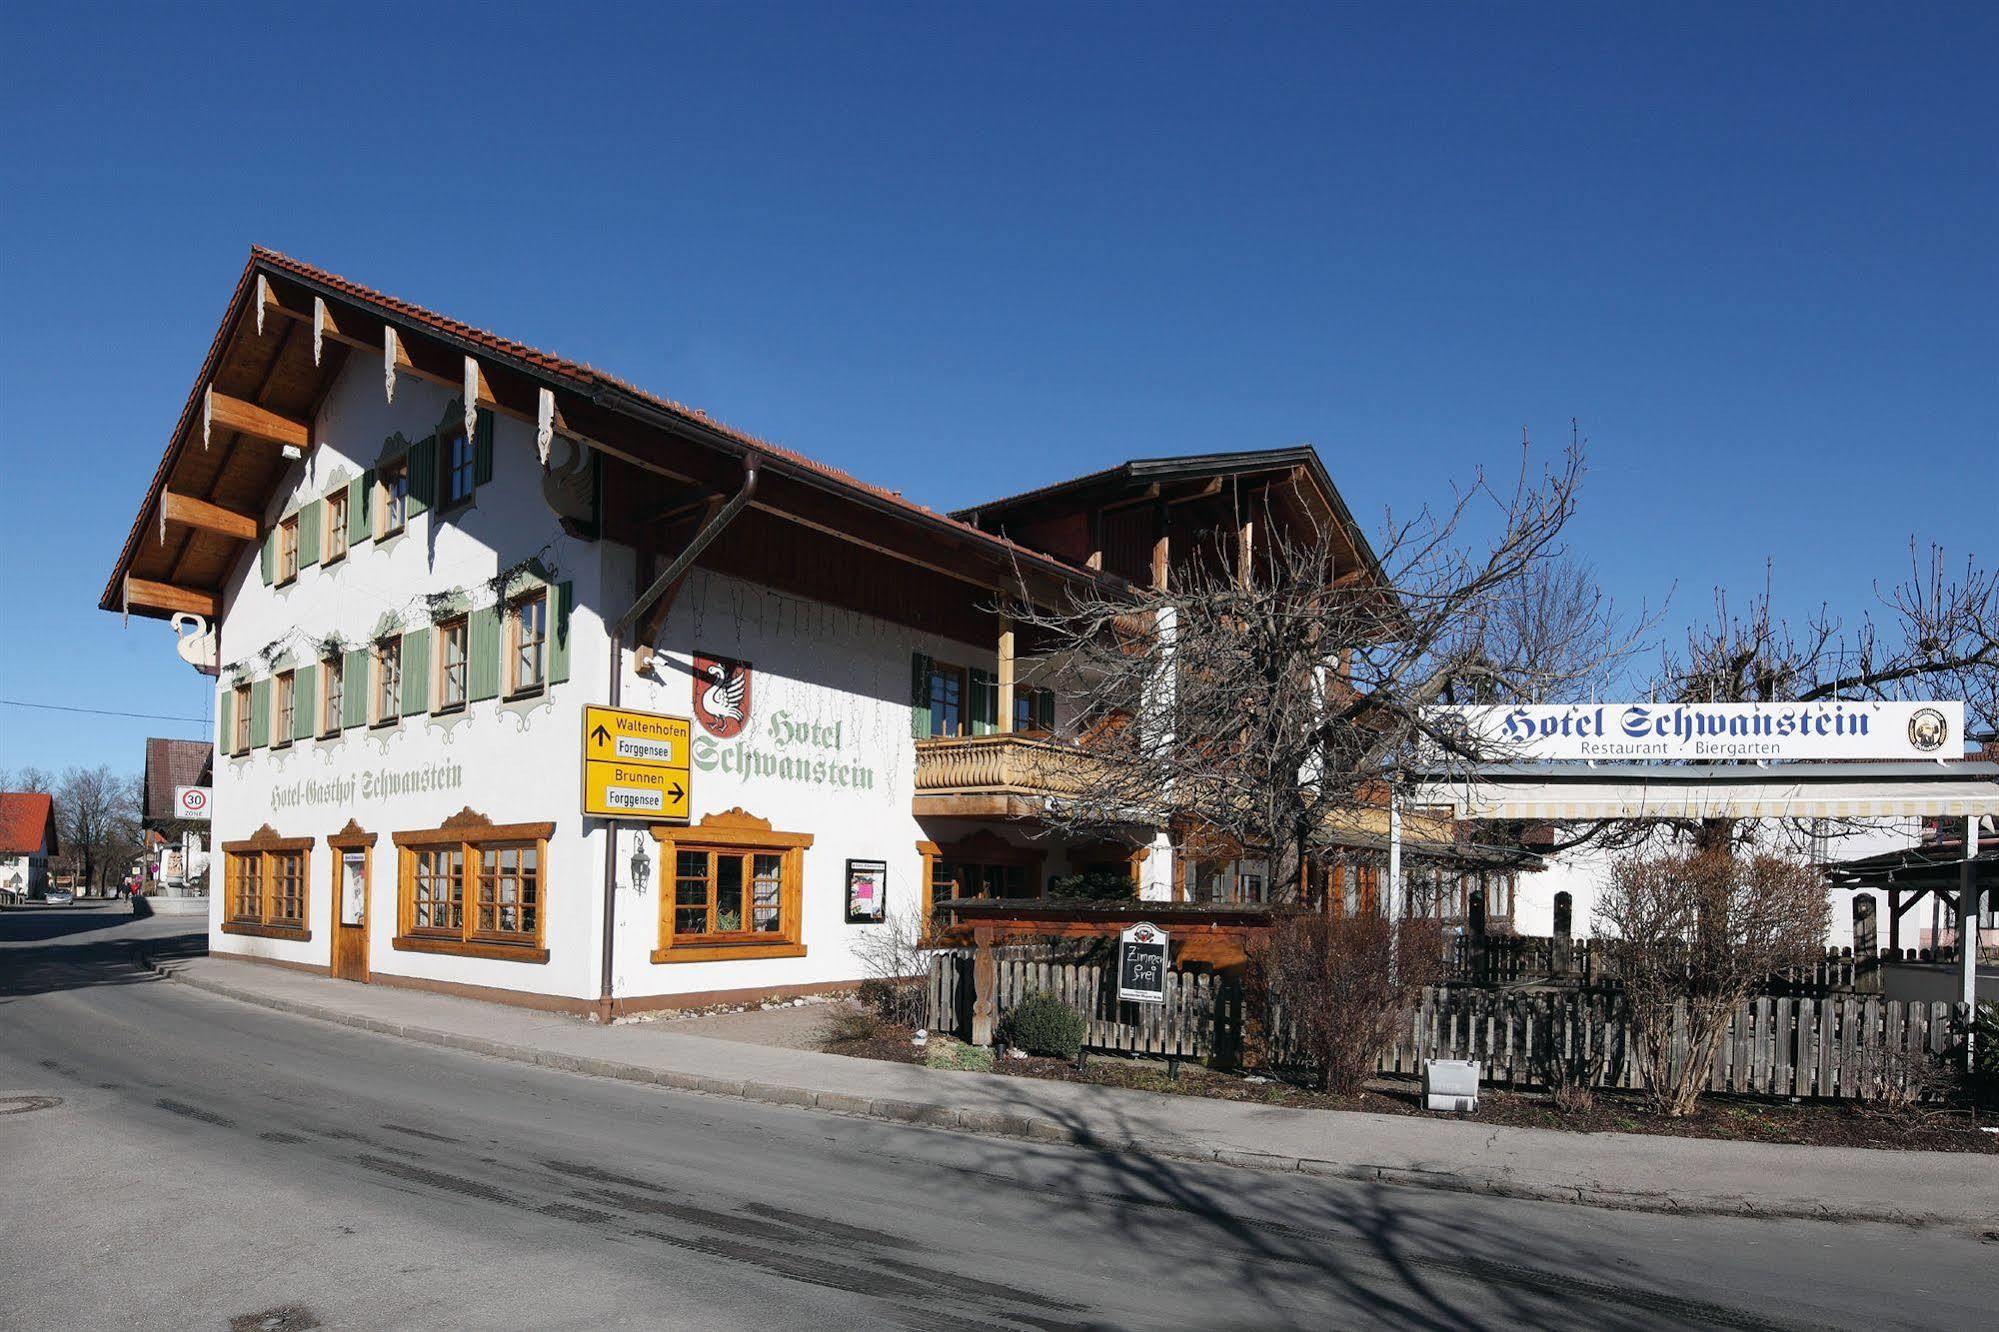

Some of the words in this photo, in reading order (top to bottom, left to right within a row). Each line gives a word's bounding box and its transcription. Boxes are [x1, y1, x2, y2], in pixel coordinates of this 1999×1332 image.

[616, 717, 687, 738] Waltenhofen
[768, 709, 842, 752] Hotel
[1502, 706, 1604, 742] Hotel
[1620, 705, 1869, 744] Schwanstein
[619, 740, 668, 757] Forggensee
[1581, 741, 1668, 754] Restaurant
[1695, 741, 1780, 756] Biergarten
[692, 736, 874, 790] Schwanstein
[271, 773, 356, 813] Hotel-Gasthof
[362, 757, 463, 805] Schwanstein
[615, 768, 664, 784] Brunnen
[187, 794, 202, 805] 30
[609, 790, 659, 807] Forggensee
[1126, 945, 1163, 965] Zimmer
[1132, 963, 1157, 982] frei
